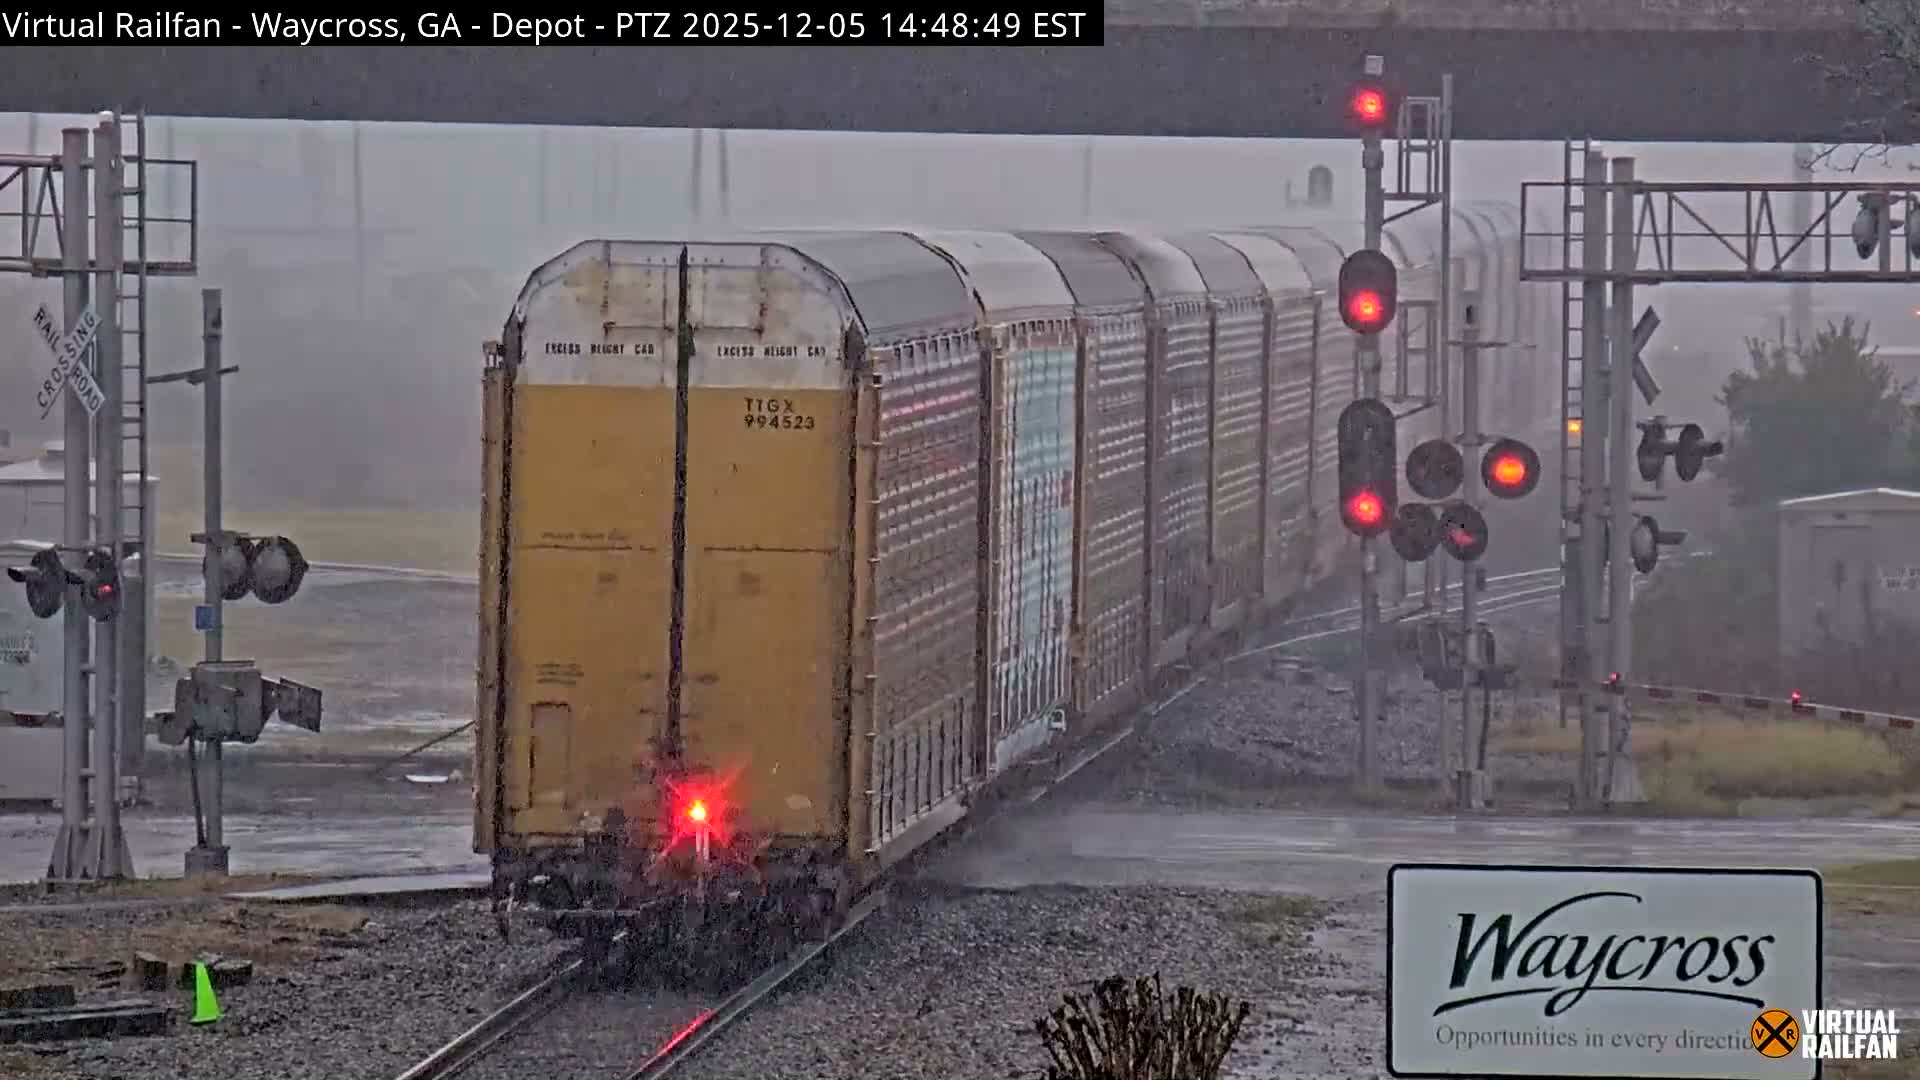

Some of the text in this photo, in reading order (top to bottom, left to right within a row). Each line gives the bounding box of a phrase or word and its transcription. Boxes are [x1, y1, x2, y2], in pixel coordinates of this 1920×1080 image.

[33, 305, 100, 412] RAIL ROAD
[36, 310, 96, 409] CROSSING
[743, 396, 794, 413] TTGX
[743, 413, 815, 430] 994523
[1449, 891, 1776, 1017] Waycross
[1435, 1023, 1752, 1053] Opportunities in every directio
